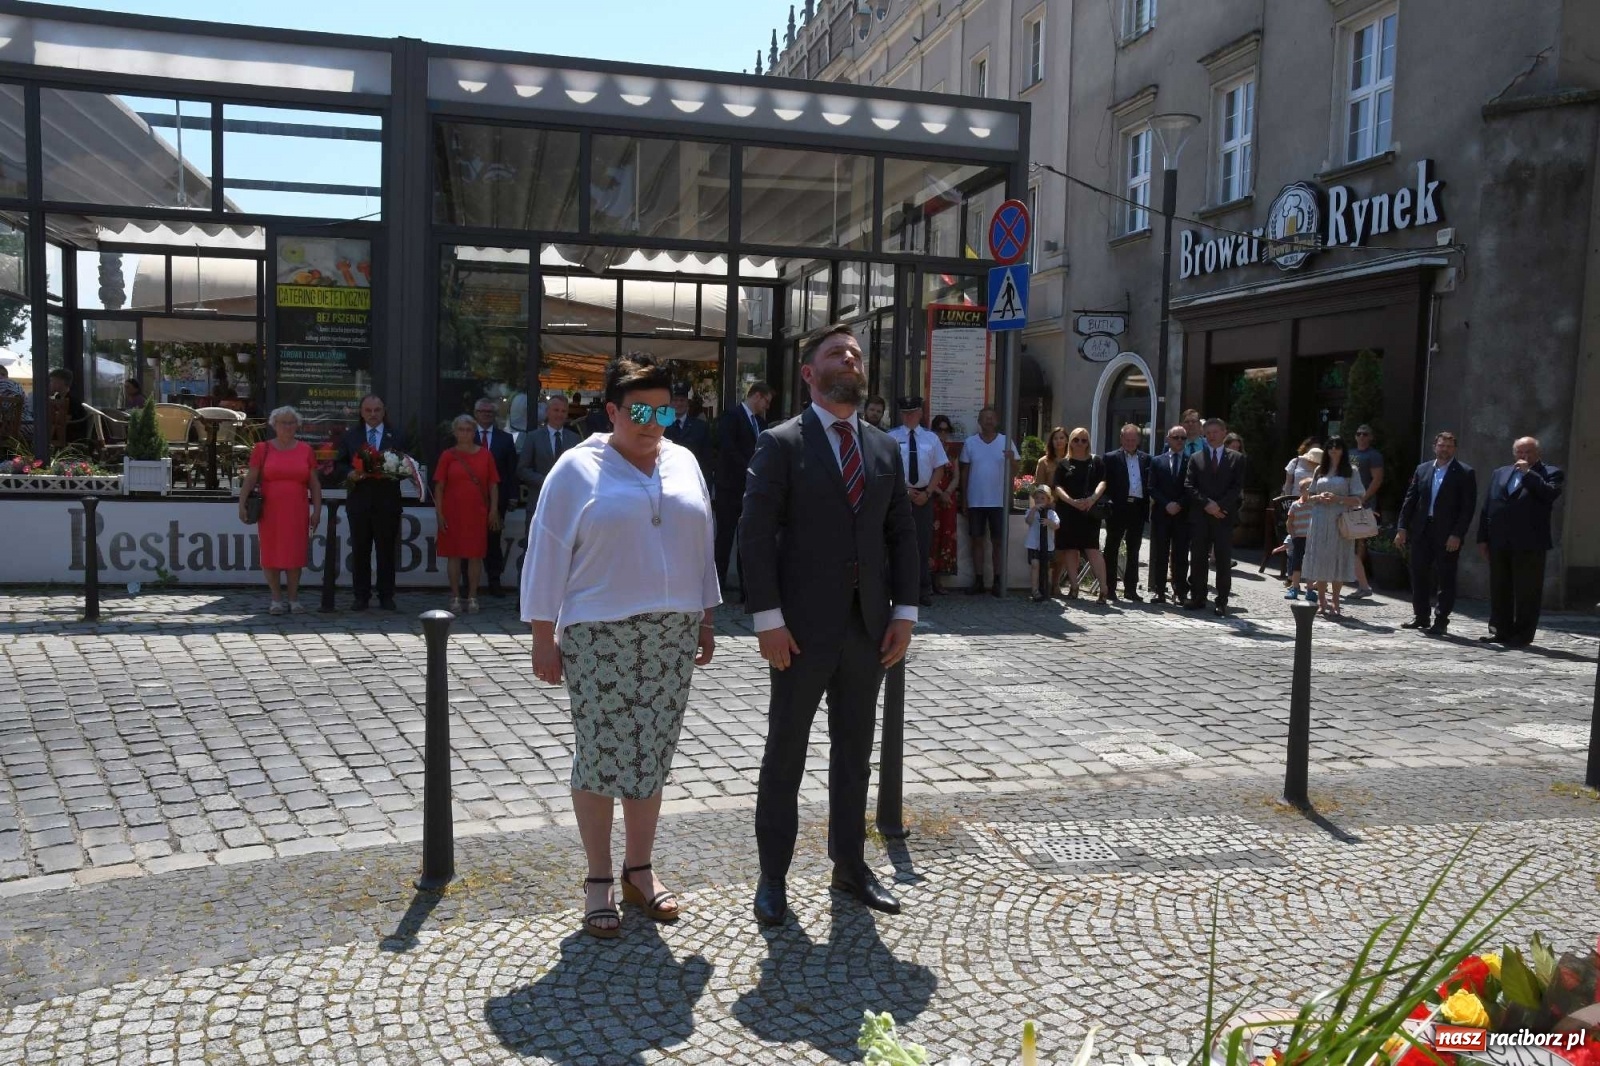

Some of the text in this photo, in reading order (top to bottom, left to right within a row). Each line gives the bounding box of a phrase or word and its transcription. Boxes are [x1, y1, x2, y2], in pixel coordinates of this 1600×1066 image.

[1179, 159, 1441, 280] Browar Rynek
[279, 287, 369, 307] CATERING DIETETYCZNY
[317, 312, 367, 324] BEZ PSZENICY
[940, 309, 981, 322] LUNCH
[1088, 318, 1115, 331] BUTIK
